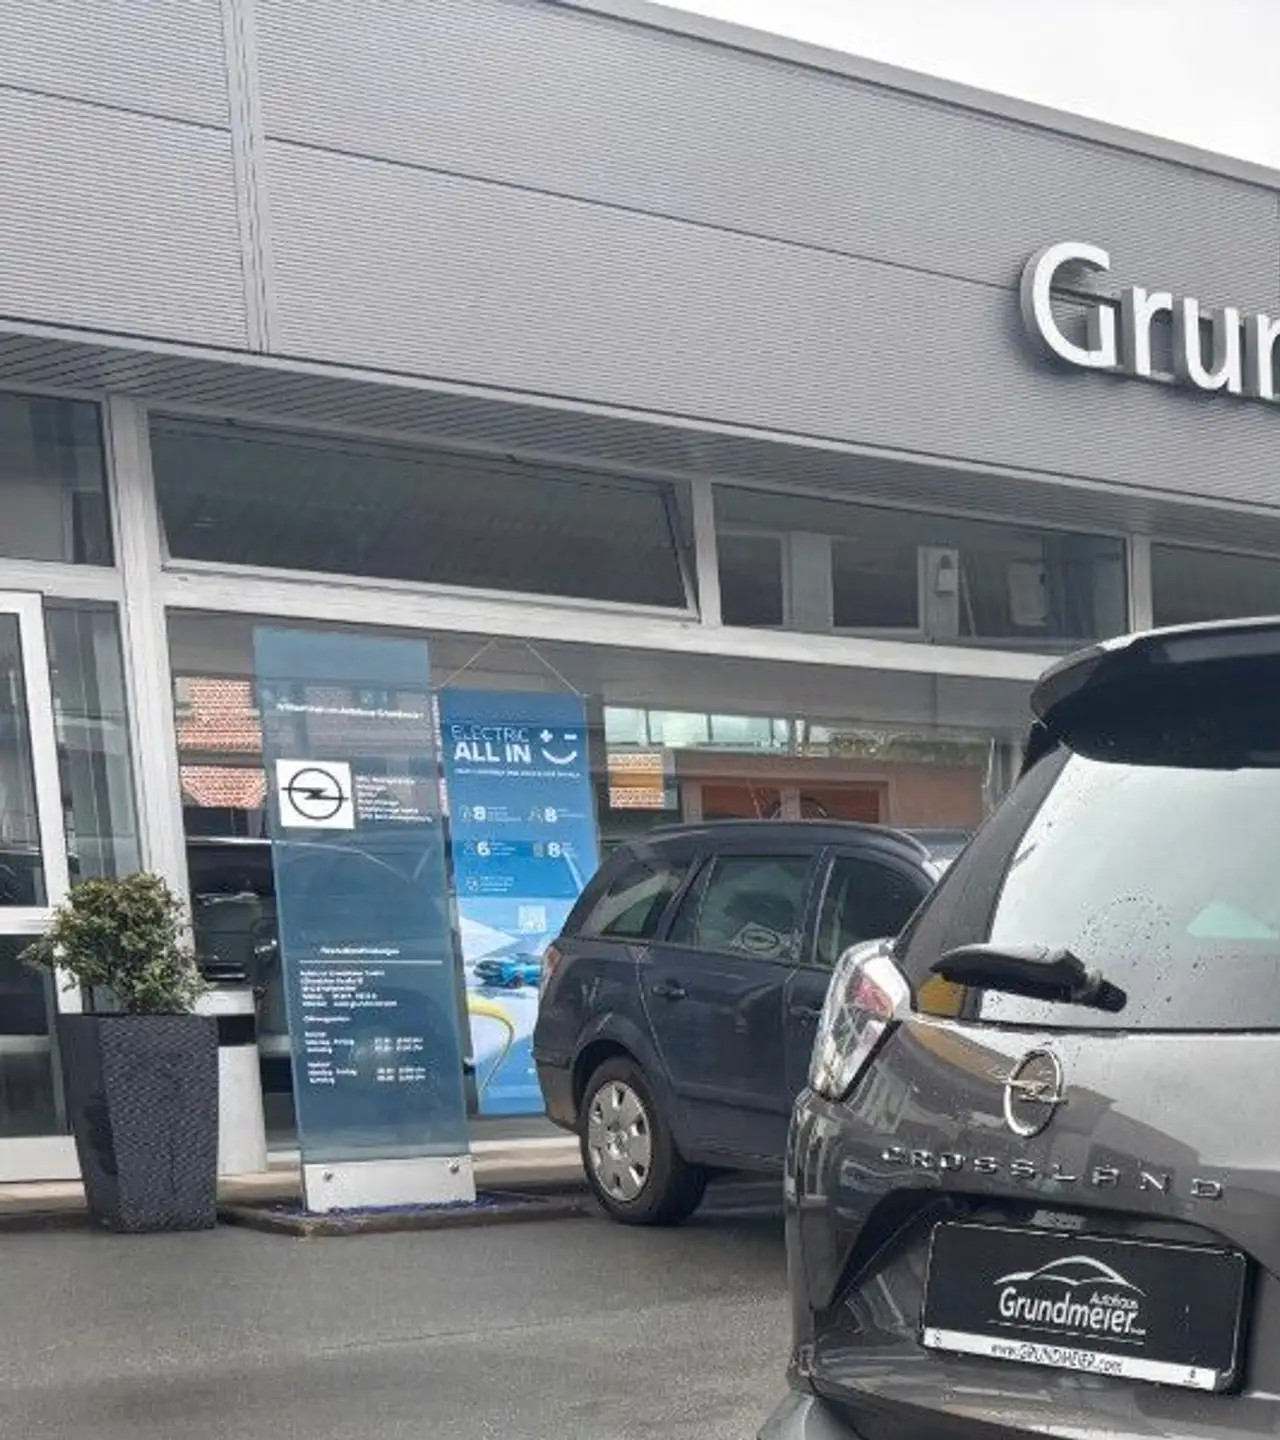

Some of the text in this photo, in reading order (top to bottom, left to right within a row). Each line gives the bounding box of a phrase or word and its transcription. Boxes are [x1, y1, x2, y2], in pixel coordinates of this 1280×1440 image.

[451, 725, 530, 743] ELECTRIC
[453, 741, 532, 764] ALL IN
[544, 806, 558, 823] 8
[476, 840, 491, 857] 6
[547, 841, 561, 858] 8
[881, 1146, 1223, 1199] CROSSLAND
[999, 1286, 1139, 1335] Grundmeier
